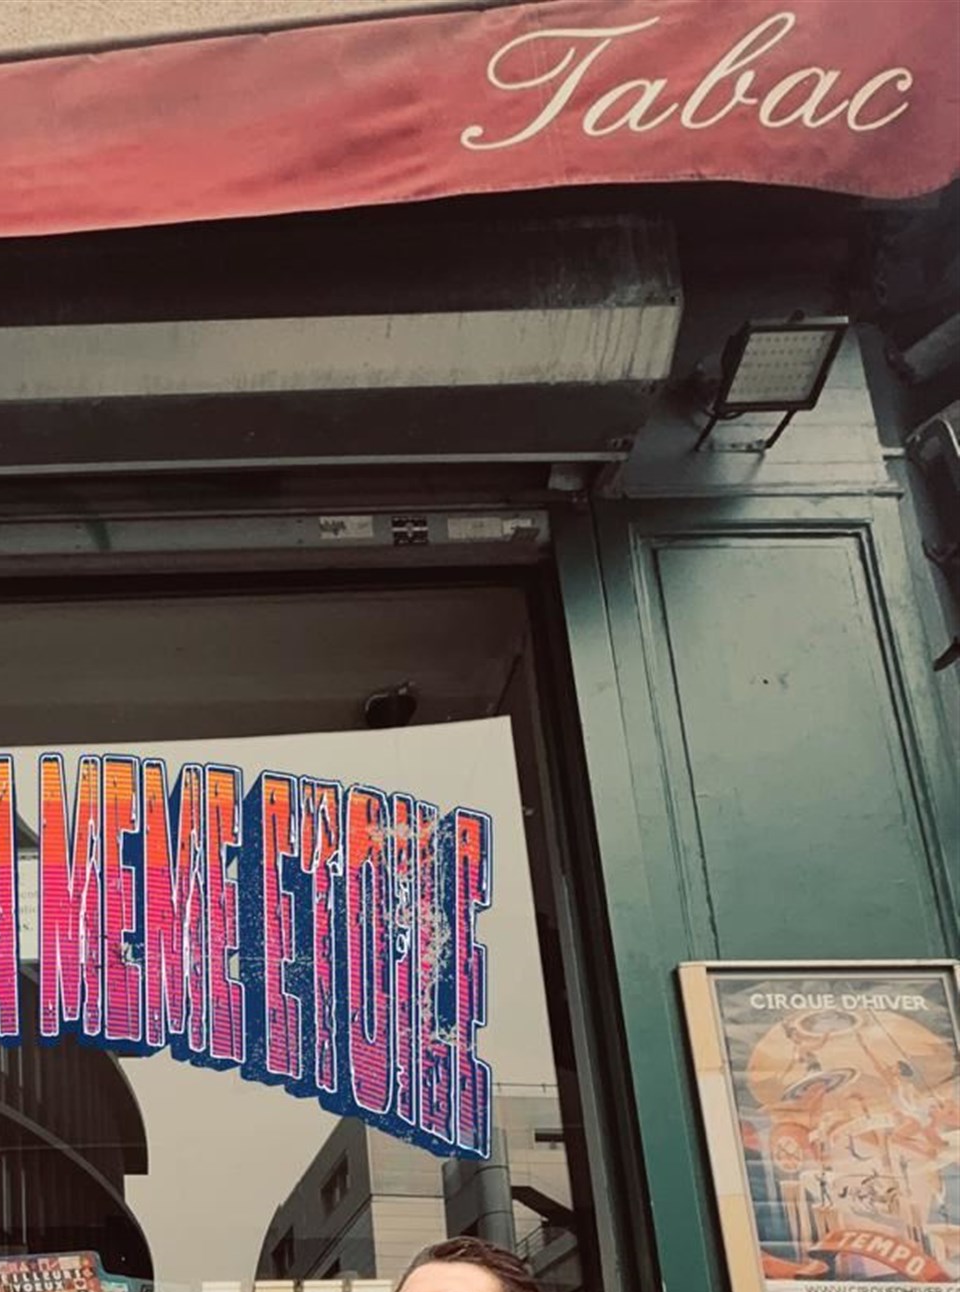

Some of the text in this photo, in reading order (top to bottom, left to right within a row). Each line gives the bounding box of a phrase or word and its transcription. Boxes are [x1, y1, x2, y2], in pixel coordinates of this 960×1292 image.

[460, 12, 914, 150] Tabac
[749, 993, 929, 1010] CIRQUE D'HIVER
[840, 1231, 926, 1276] TEMPO
